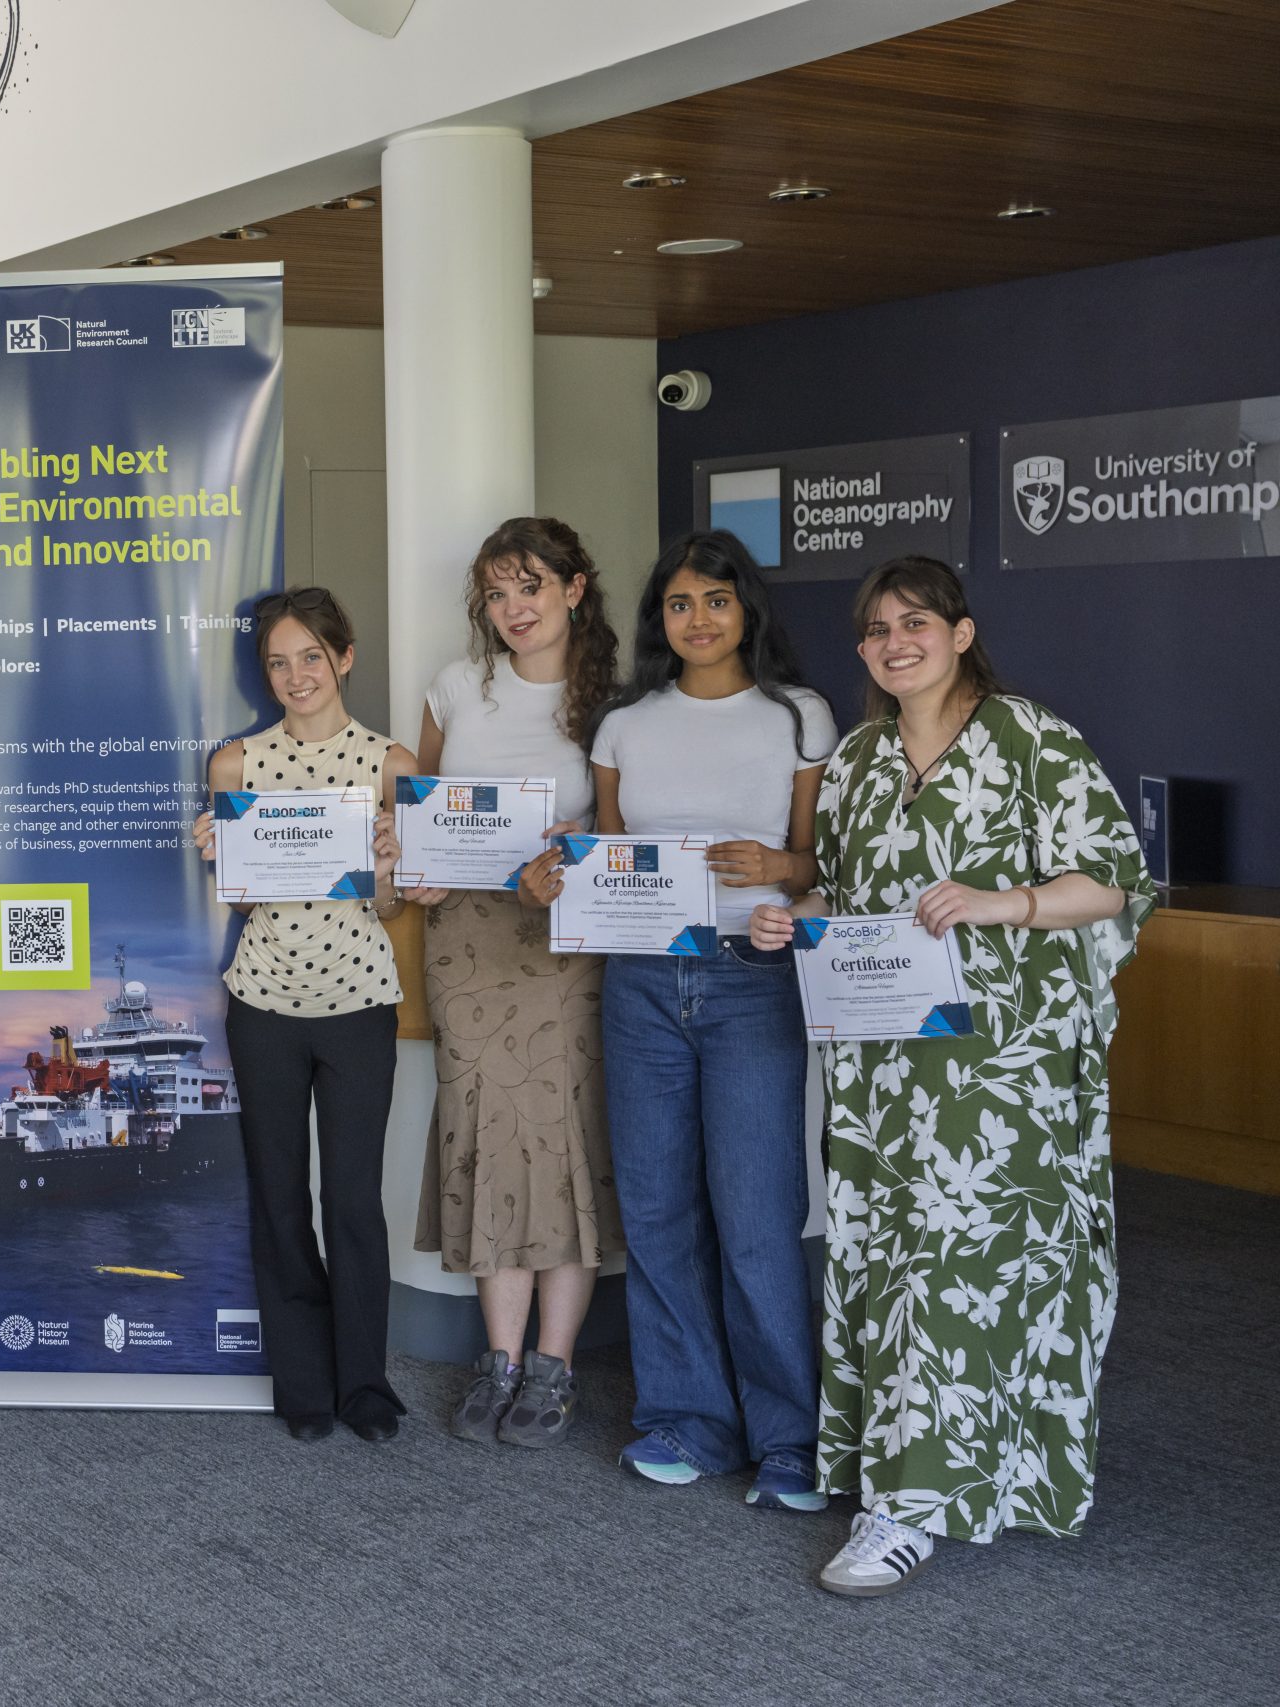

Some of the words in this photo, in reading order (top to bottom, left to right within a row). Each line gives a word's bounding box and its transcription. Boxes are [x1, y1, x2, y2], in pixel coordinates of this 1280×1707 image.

[76, 320, 107, 330] Natural
[76, 327, 129, 338] Environment
[76, 337, 114, 348] Research
[116, 336, 148, 346] Council
[90, 443, 168, 475] Next
[1094, 445, 1220, 481] University
[1227, 442, 1255, 468] of
[792, 472, 882, 502] National
[0, 486, 242, 523] Environmental
[1066, 479, 1280, 523] Southamp
[792, 495, 953, 528] Oceanography
[792, 528, 864, 552] Centre
[43, 532, 211, 566] Innovation
[57, 616, 157, 633] Placements
[180, 614, 253, 633] Training
[32, 738, 66, 754] with
[70, 738, 95, 753] the
[99, 738, 146, 757] global
[149, 736, 239, 752] environme
[26, 781, 60, 795] funds
[64, 781, 89, 794] PhD
[92, 781, 169, 796] studentships
[173, 780, 198, 793] that
[3, 800, 78, 815] researchers,
[80, 800, 114, 815] equip
[118, 799, 149, 812] them
[152, 799, 179, 811] with
[182, 799, 203, 811] the
[13, 819, 57, 834] change
[60, 819, 82, 831] and
[85, 818, 118, 831] other
[122, 817, 194, 831] environmen
[434, 813, 512, 827] Certificate
[254, 827, 333, 840] Certificate
[457, 828, 496, 836] completion
[5, 838, 19, 851] of
[21, 837, 76, 852] business,
[79, 837, 152, 852] government
[156, 836, 178, 849] and
[279, 841, 318, 849] completion
[593, 874, 673, 888] Certificate
[619, 889, 658, 897] completion
[833, 926, 880, 938] SoCoBio
[832, 956, 911, 972] Certificate
[848, 973, 855, 981] of
[857, 972, 898, 981] completion
[38, 1337, 69, 1345] Museum
[129, 1330, 165, 1338] Biological
